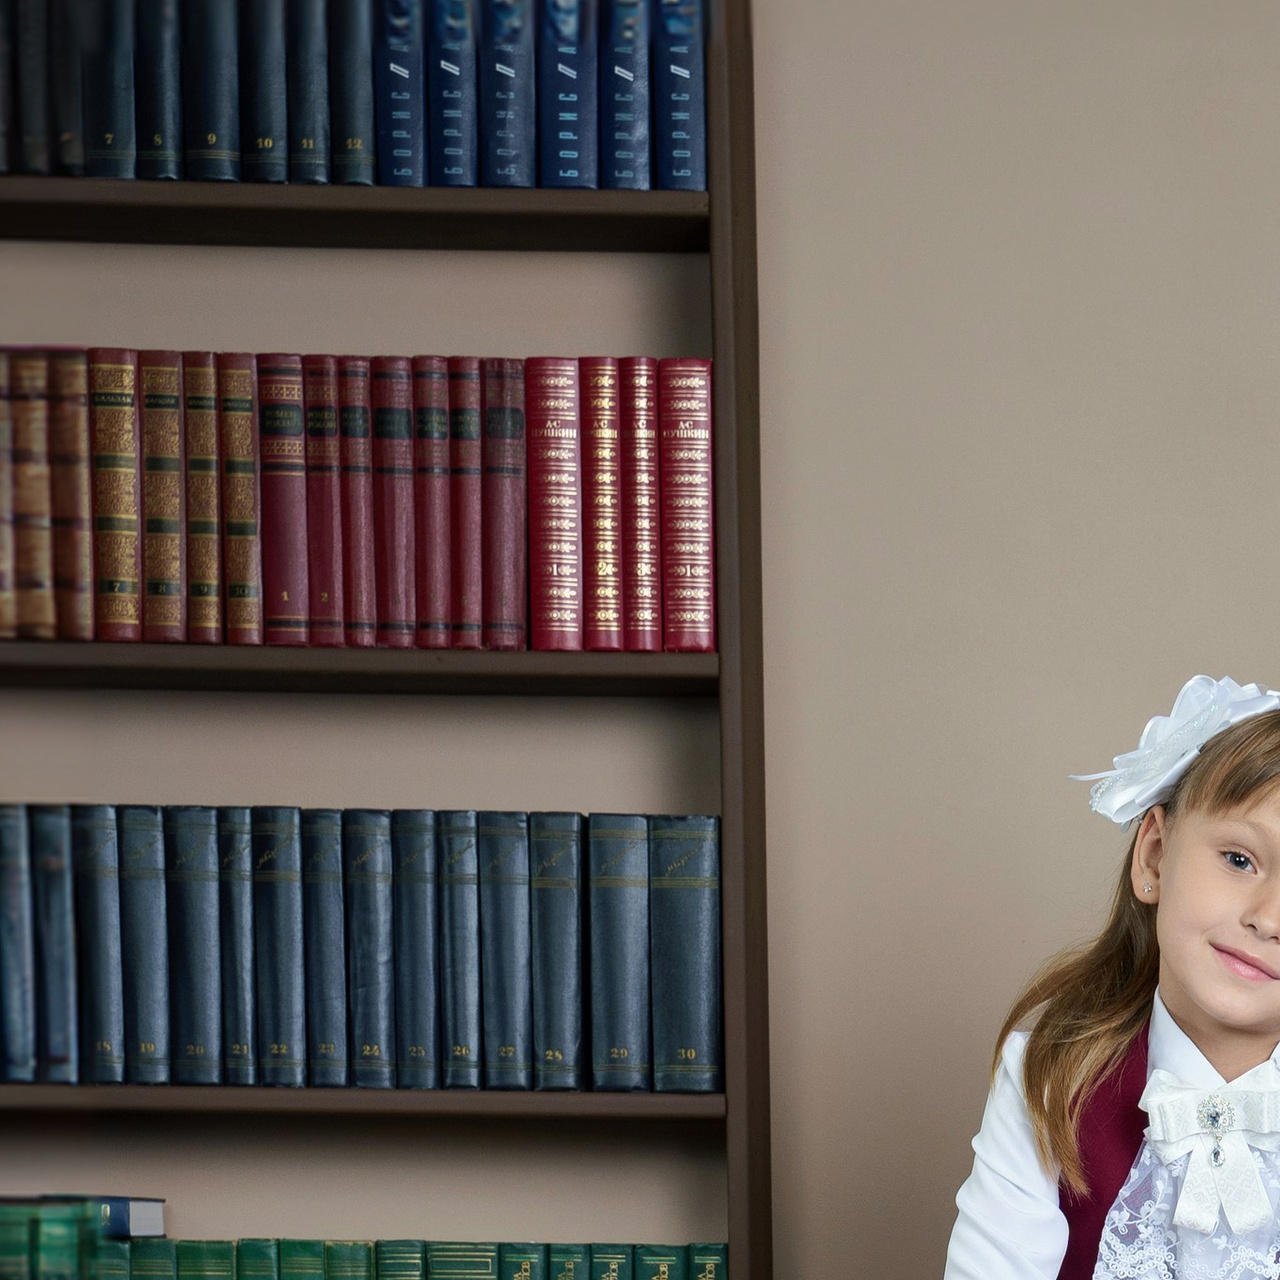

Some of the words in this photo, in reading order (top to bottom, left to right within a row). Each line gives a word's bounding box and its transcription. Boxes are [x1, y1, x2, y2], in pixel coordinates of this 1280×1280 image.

[105, 134, 114, 145] 7
[154, 135, 163, 145] 8
[207, 134, 217, 145] 9
[256, 138, 273, 149] 10
[301, 139, 315, 149] 11
[346, 138, 364, 150] 12
[270, 1044, 288, 1054] 22
[363, 1046, 380, 1056] 24
[610, 1048, 629, 1058] 29
[678, 1048, 697, 1059] 30
